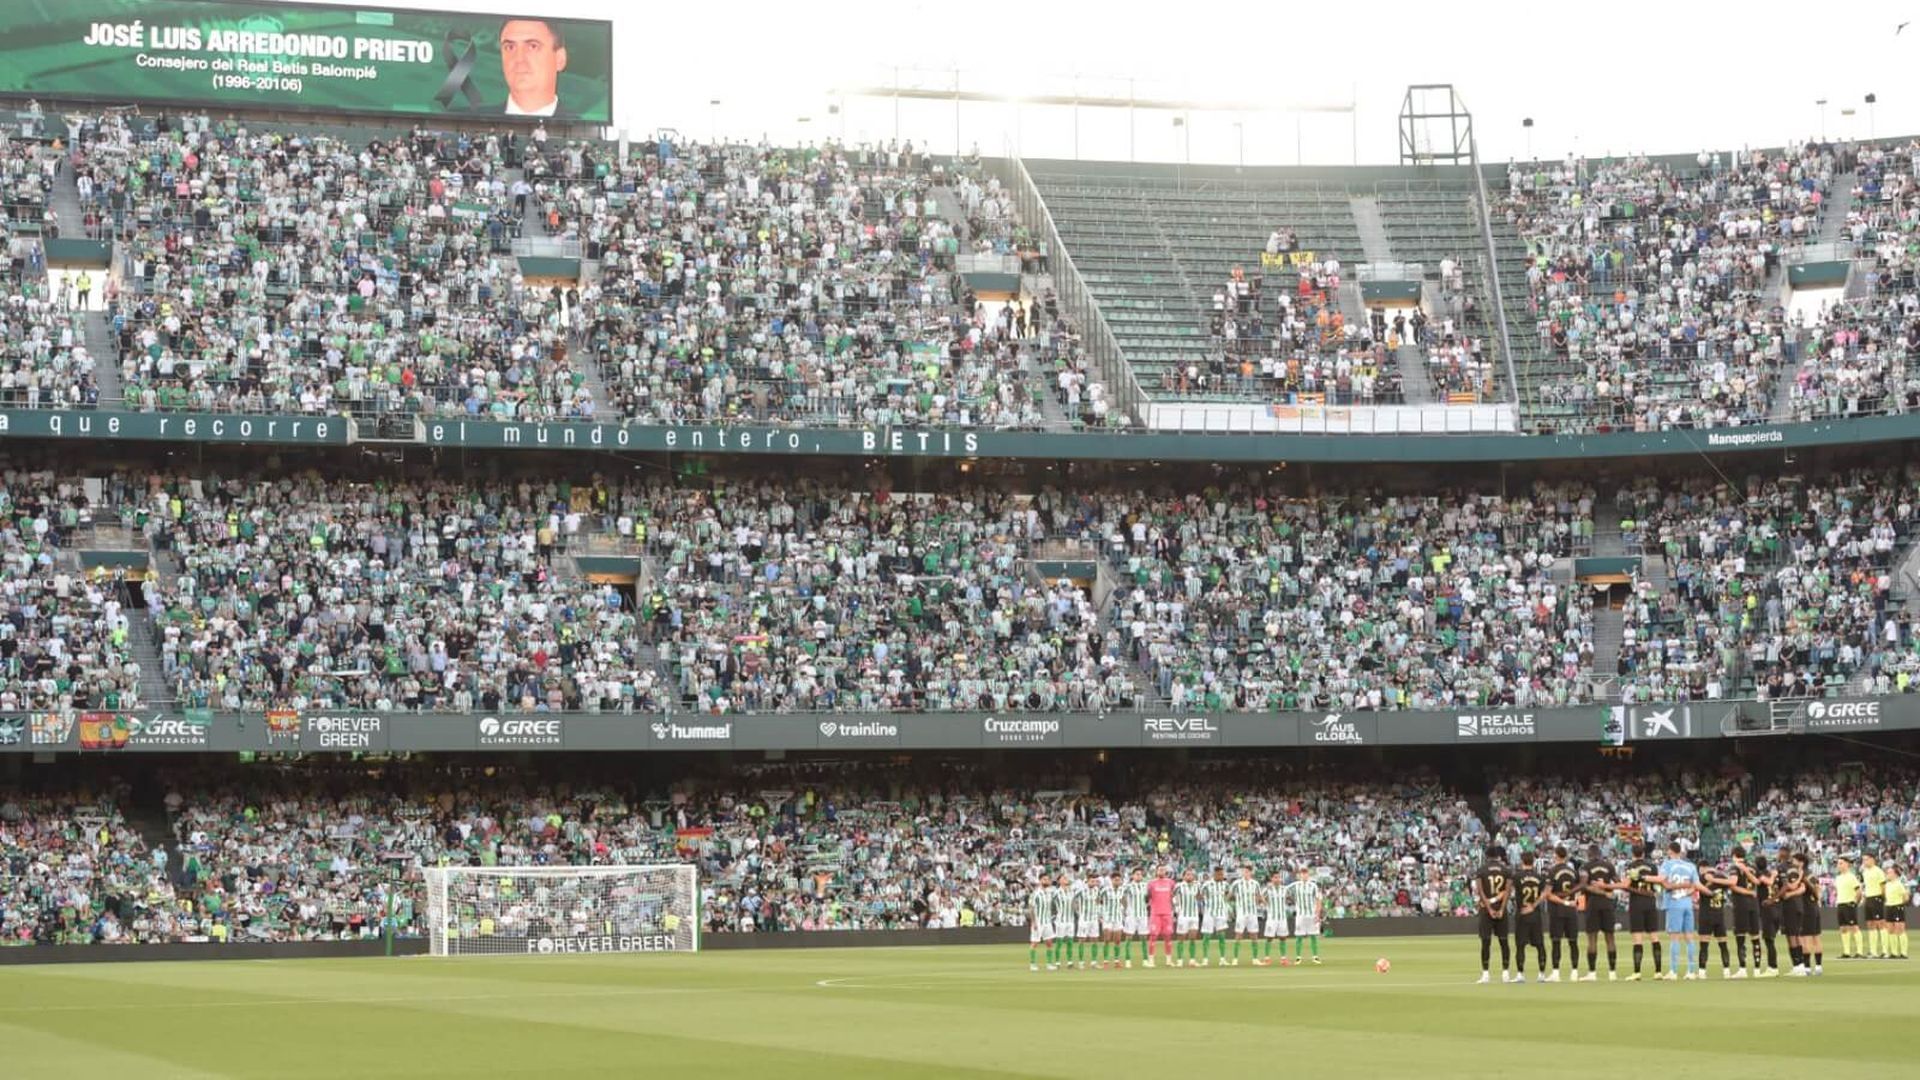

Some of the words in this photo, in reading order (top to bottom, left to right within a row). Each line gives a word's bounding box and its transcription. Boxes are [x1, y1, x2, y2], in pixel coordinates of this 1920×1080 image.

[84, 20, 144, 47] JOSÉ
[151, 26, 202, 50] LUIS
[207, 30, 348, 58] ARREDONDO
[354, 37, 433, 63] PRIETO
[136, 53, 208, 71] Consejero
[212, 58, 233, 71] del
[238, 59, 268, 73] Real
[272, 61, 308, 75] Betis
[312, 63, 377, 80] Balompié
[213, 74, 302, 93] (1996-20106)
[50, 415, 120, 436] que
[160, 418, 328, 438] recorre
[433, 421, 465, 441] el
[503, 425, 629, 445] mundo
[863, 431, 978, 452] BETIS
[1708, 430, 1783, 447] Manquepierda
[1828, 701, 1880, 717] GREE
[308, 717, 380, 732] FOREVER
[503, 720, 561, 735] GREE
[984, 717, 1059, 735] Cruzcampo
[1144, 718, 1218, 731] REVEL
[1331, 723, 1355, 732] AUS
[1481, 714, 1534, 726] REALE
[671, 723, 731, 739] hummel
[839, 722, 897, 736] trainline
[1315, 732, 1362, 741] GLOBAL
[1481, 726, 1534, 736] SEGUROS
[320, 733, 369, 746] GREEN
[1488, 875, 1504, 896] 12
[1522, 886, 1539, 904] 21
[527, 936, 613, 953] FOREVER
[620, 935, 676, 951] GREEN
